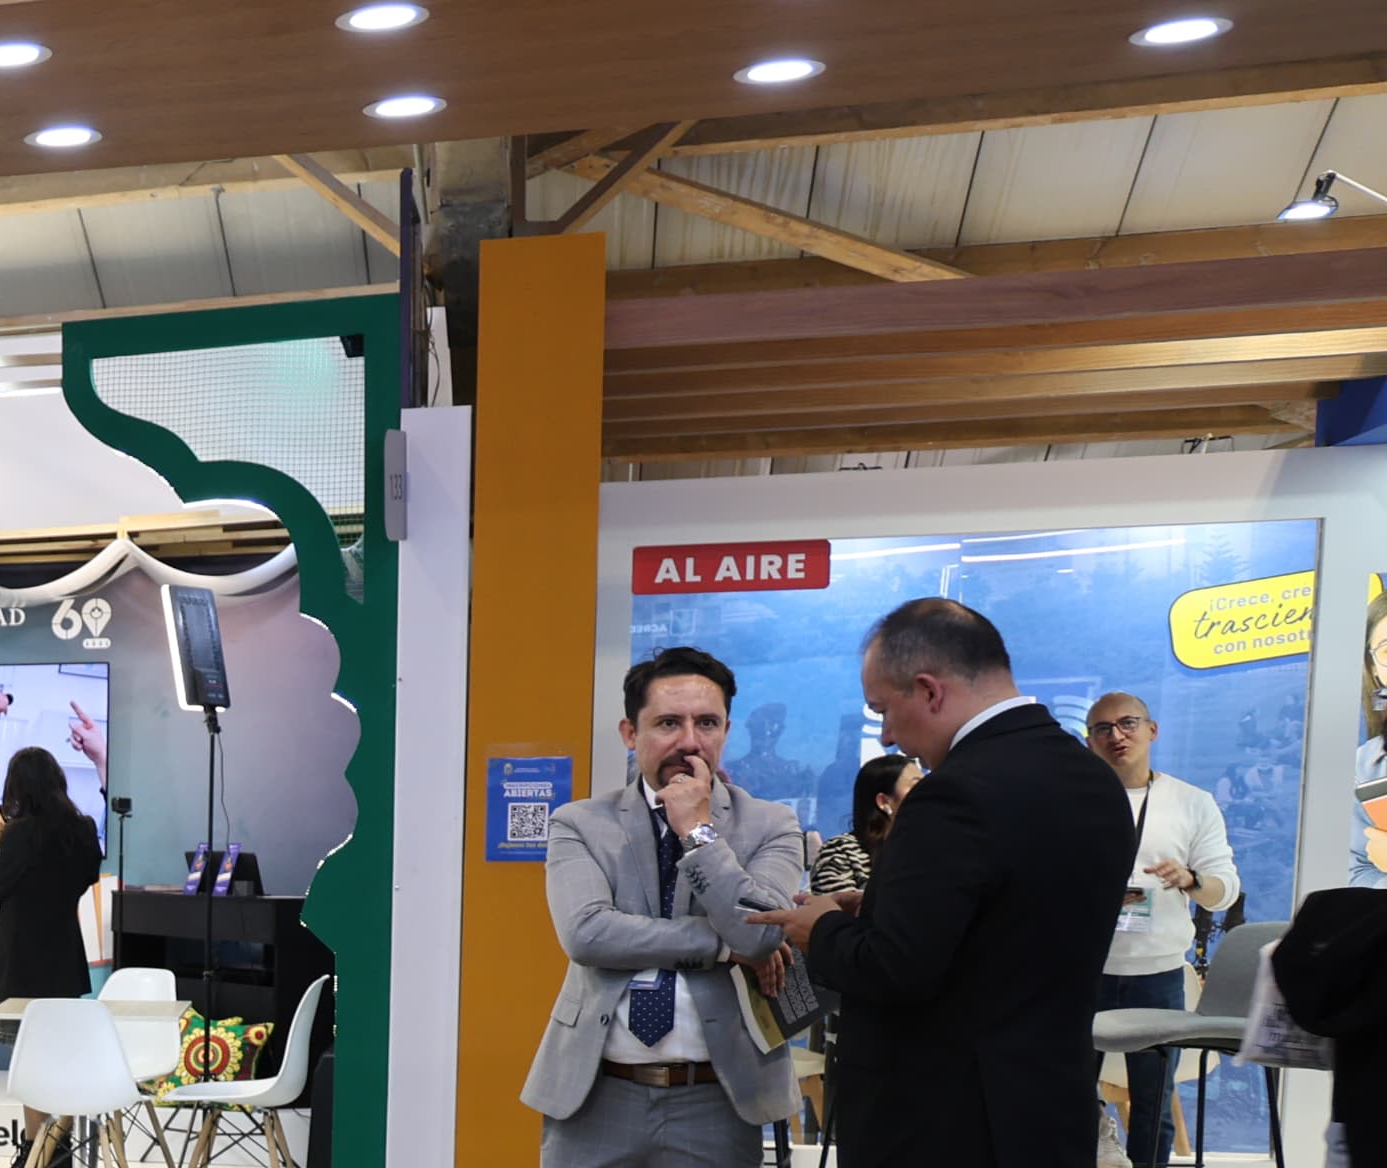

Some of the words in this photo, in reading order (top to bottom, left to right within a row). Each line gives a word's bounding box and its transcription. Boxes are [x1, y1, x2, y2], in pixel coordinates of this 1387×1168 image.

[654, 557, 702, 584] AL
[715, 553, 806, 582] AIRE
[1213, 640, 1247, 655] con
[503, 789, 552, 798] ABIERTAS
